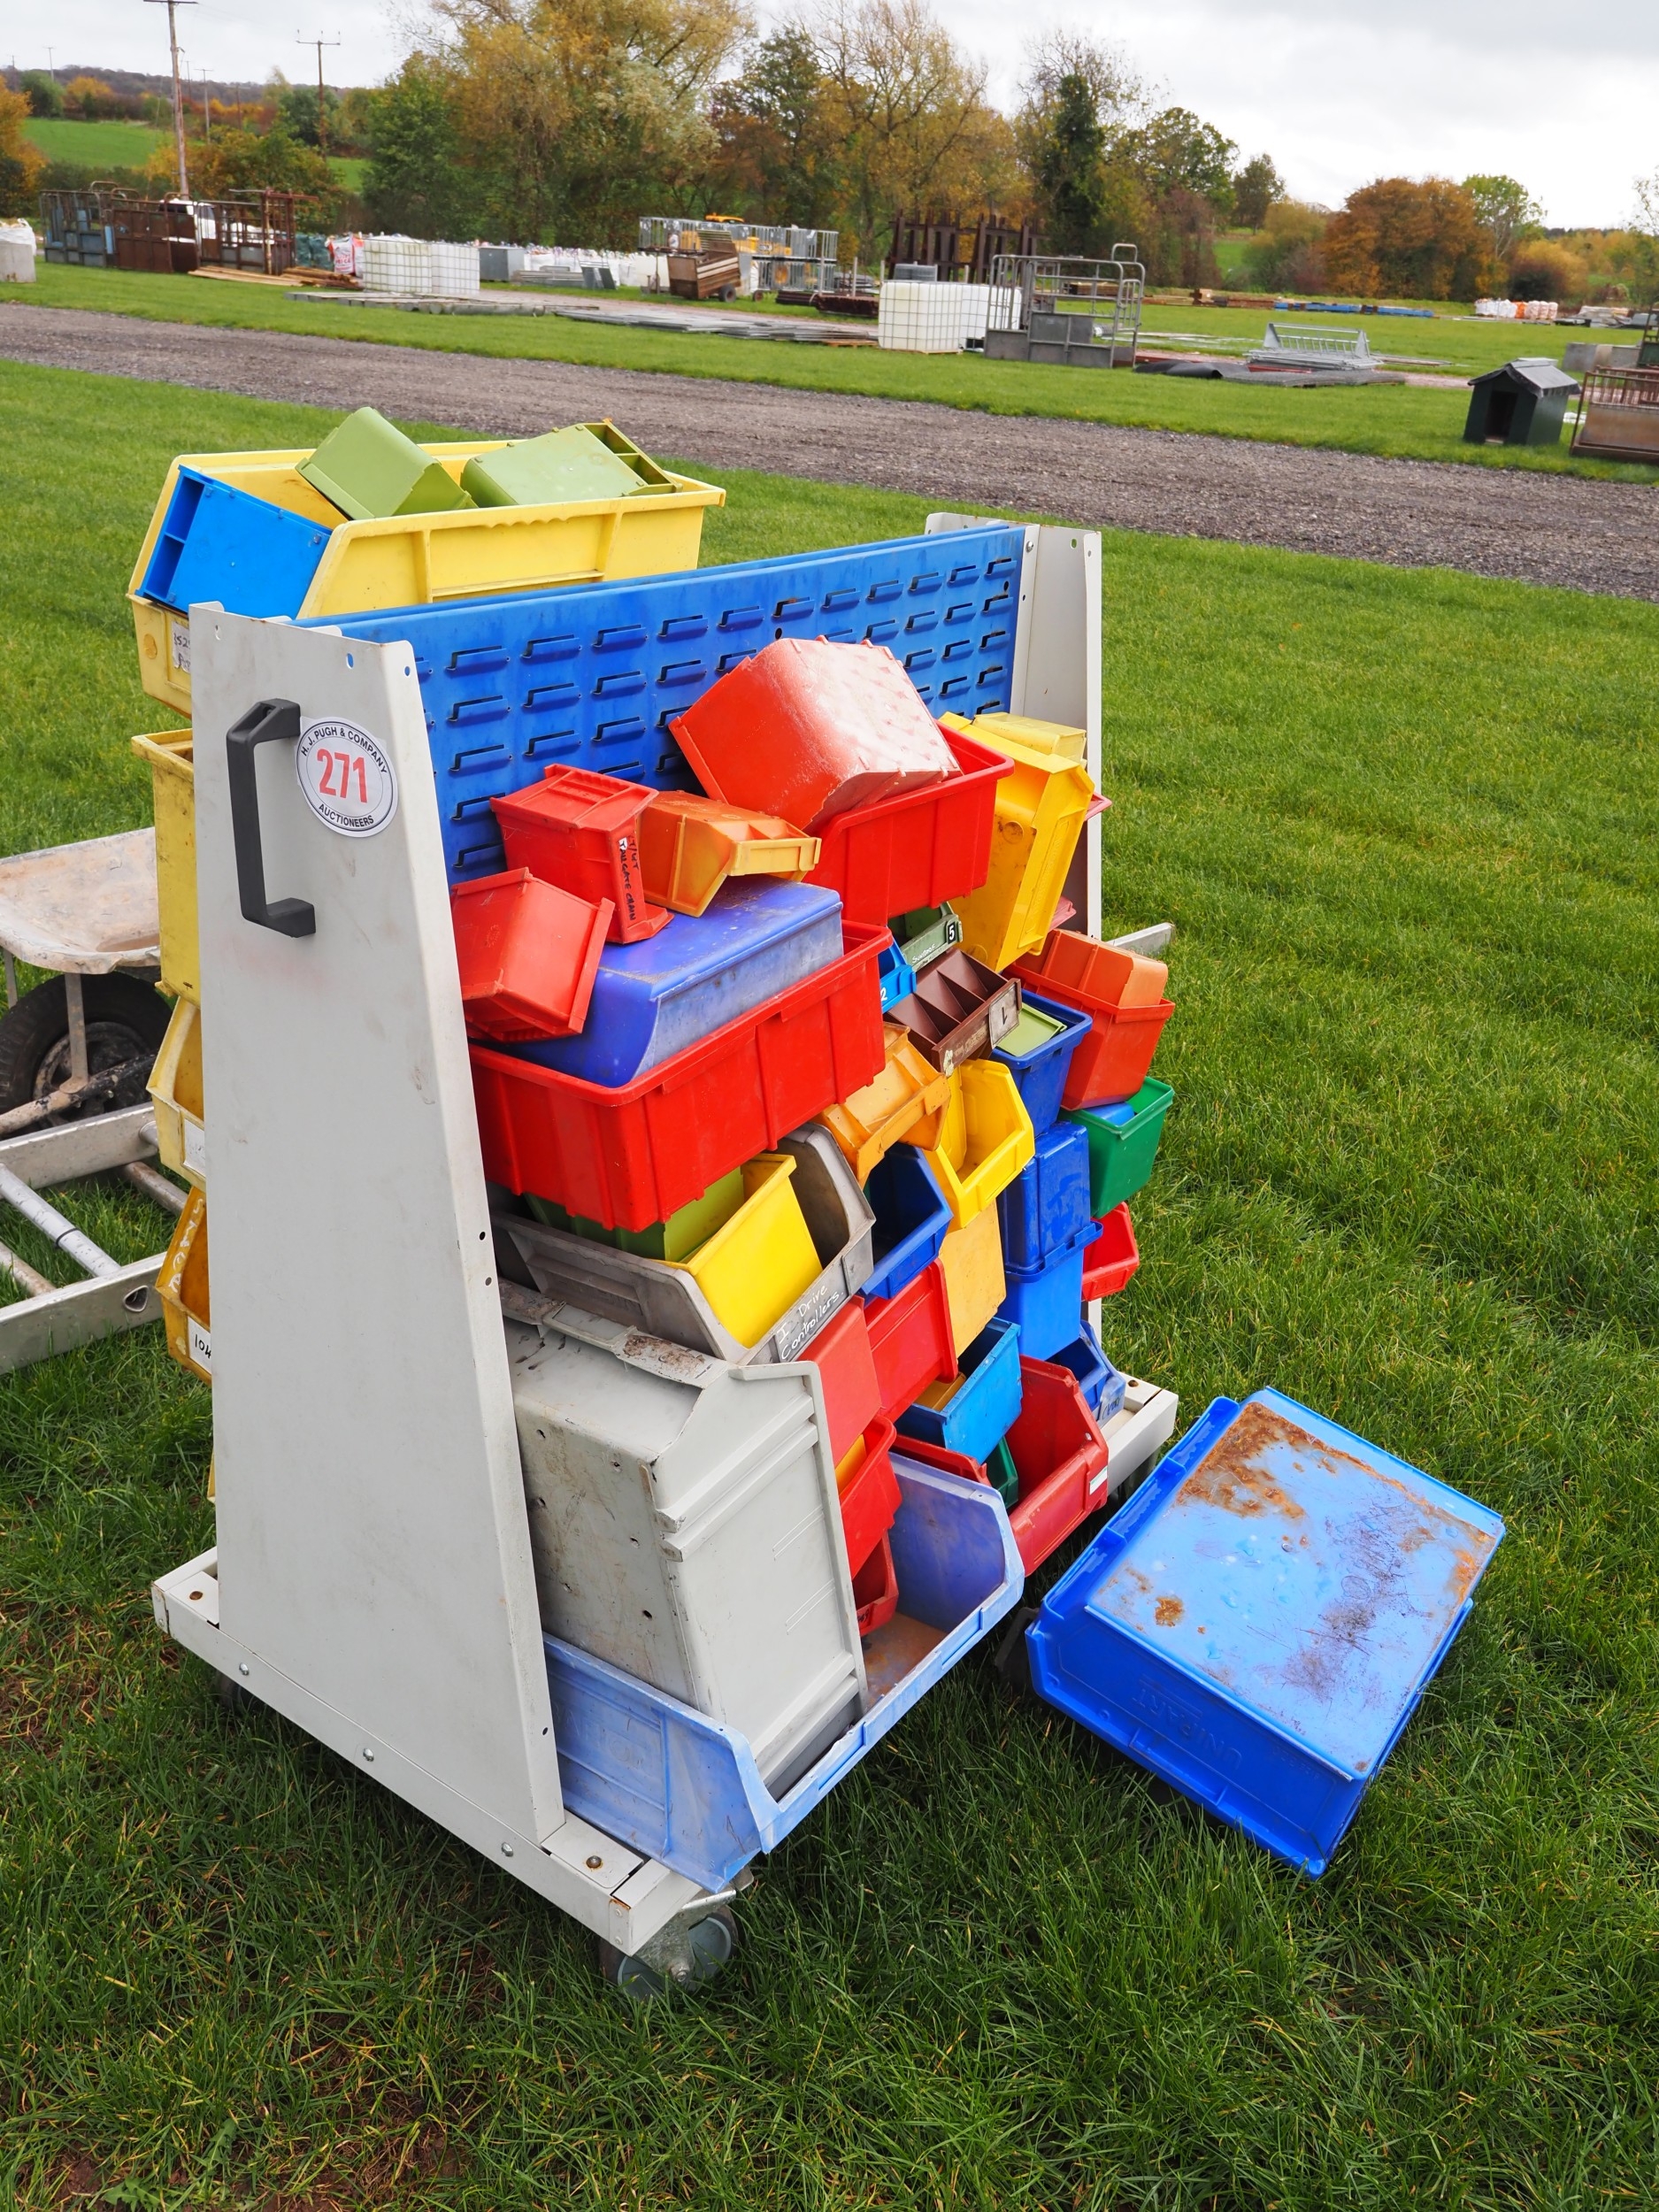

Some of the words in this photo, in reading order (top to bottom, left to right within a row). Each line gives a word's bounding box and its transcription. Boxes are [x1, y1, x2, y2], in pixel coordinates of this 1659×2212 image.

[301, 745, 309, 757] H.
[308, 736, 315, 746] J.
[314, 726, 338, 740] PUGH
[340, 727, 346, 737] &
[348, 731, 388, 774] COMPANY
[317, 749, 368, 803] 271
[319, 803, 374, 827] AUCTIONEERS
[949, 925, 956, 941] 5
[798, 1285, 828, 1317] Drive
